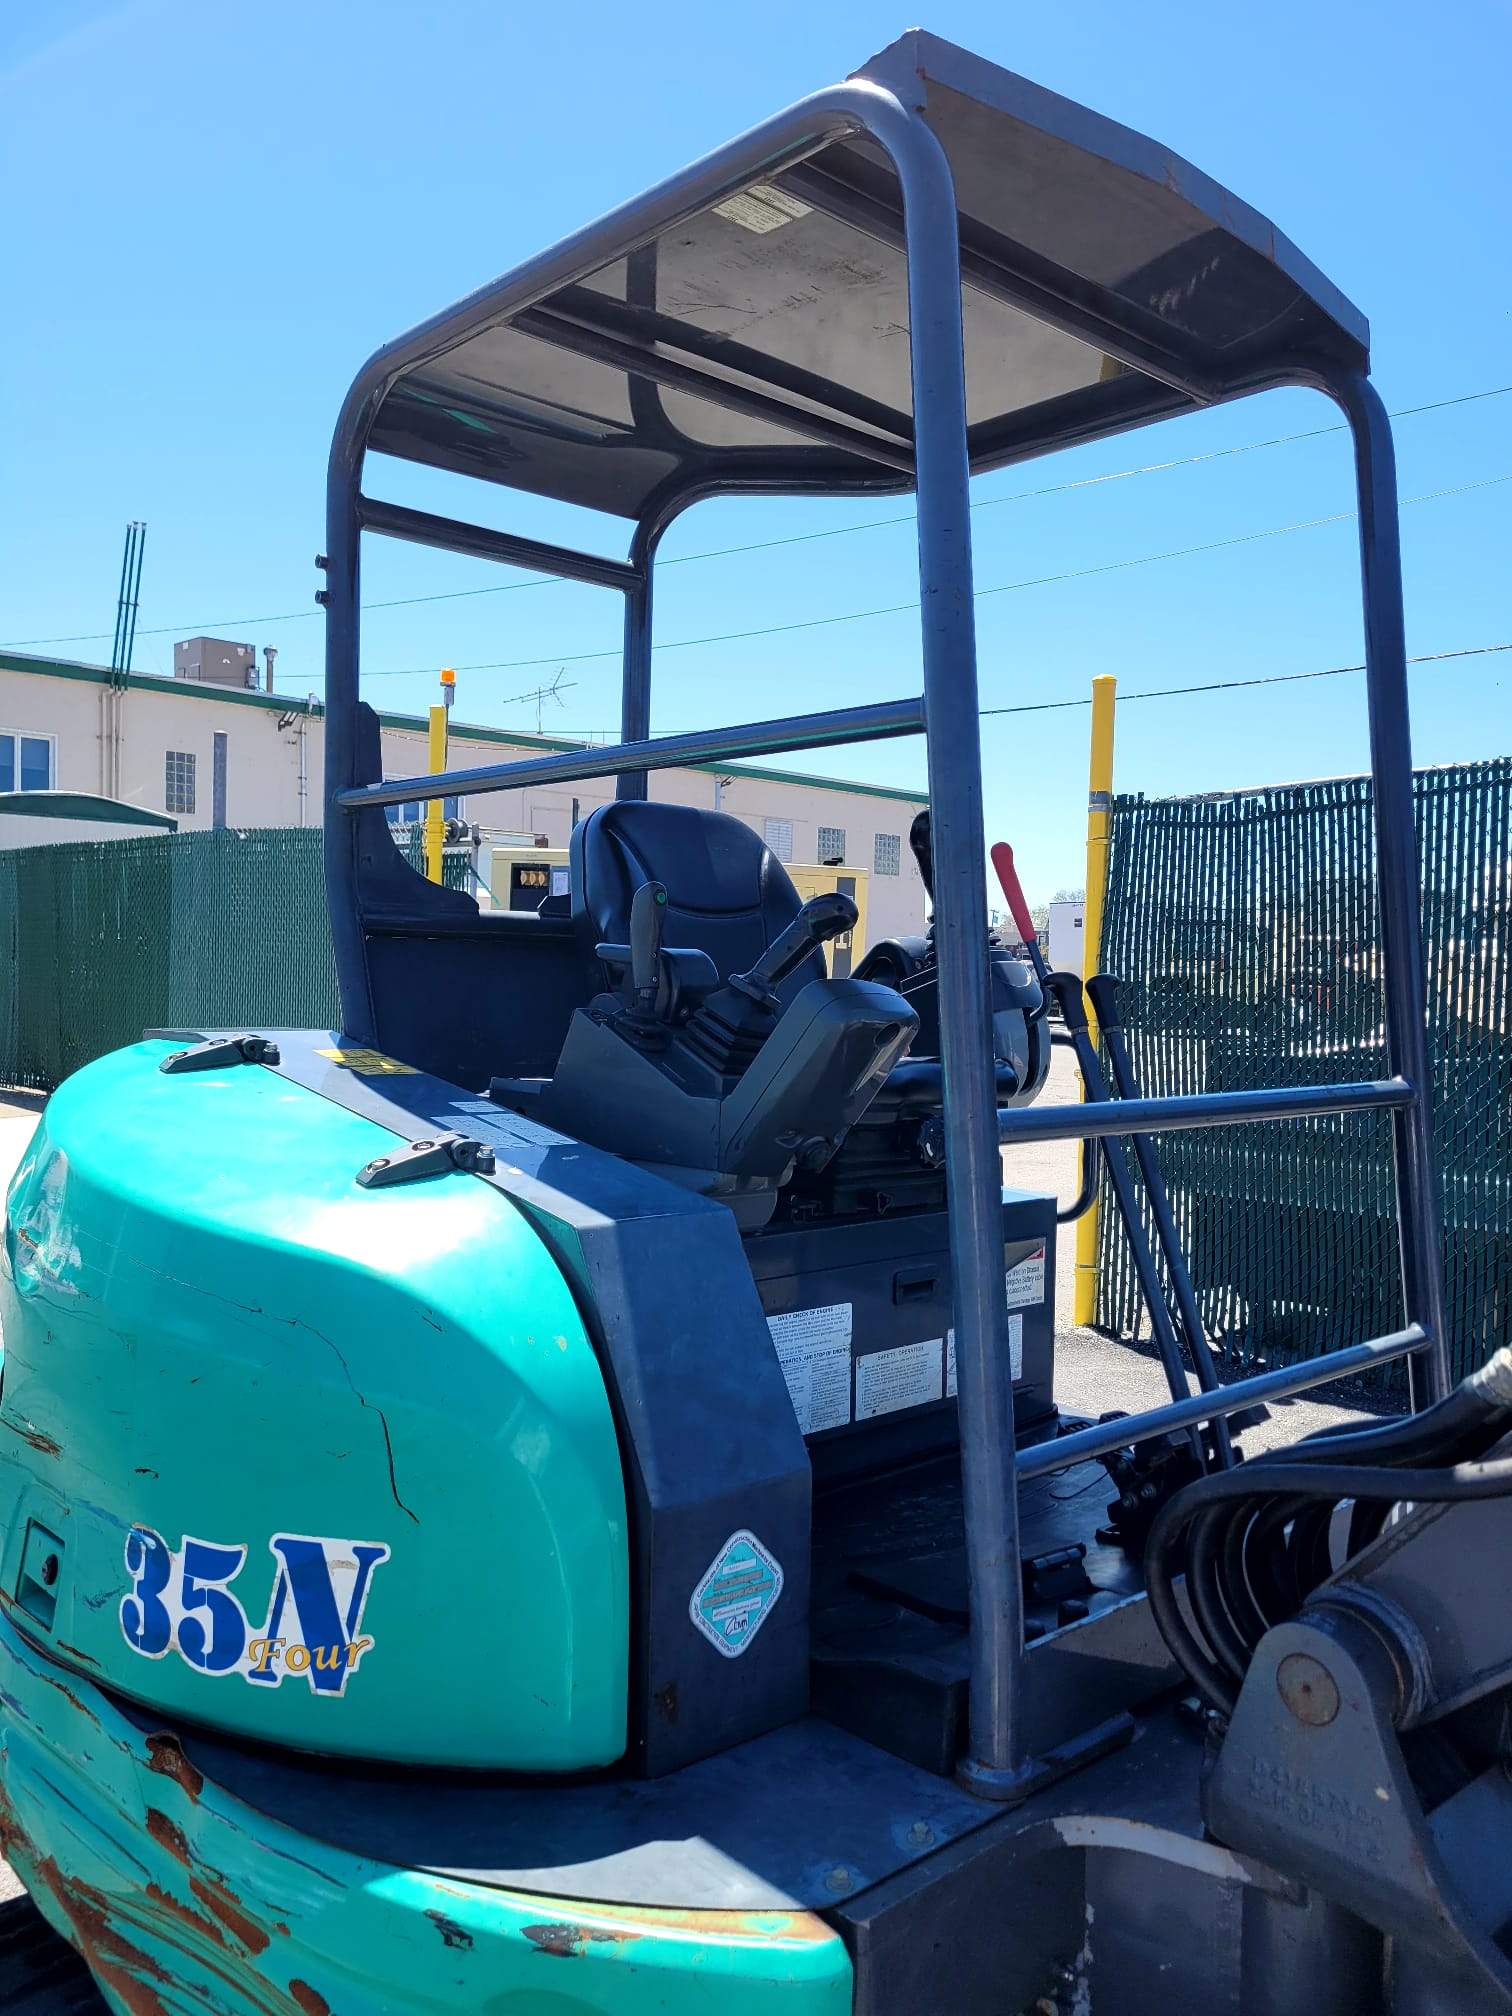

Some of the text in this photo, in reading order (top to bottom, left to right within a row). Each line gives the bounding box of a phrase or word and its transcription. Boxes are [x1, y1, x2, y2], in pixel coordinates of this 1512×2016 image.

[876, 1346, 924, 1361] SAFETY OPERATION
[249, 1637, 372, 1673] Four
